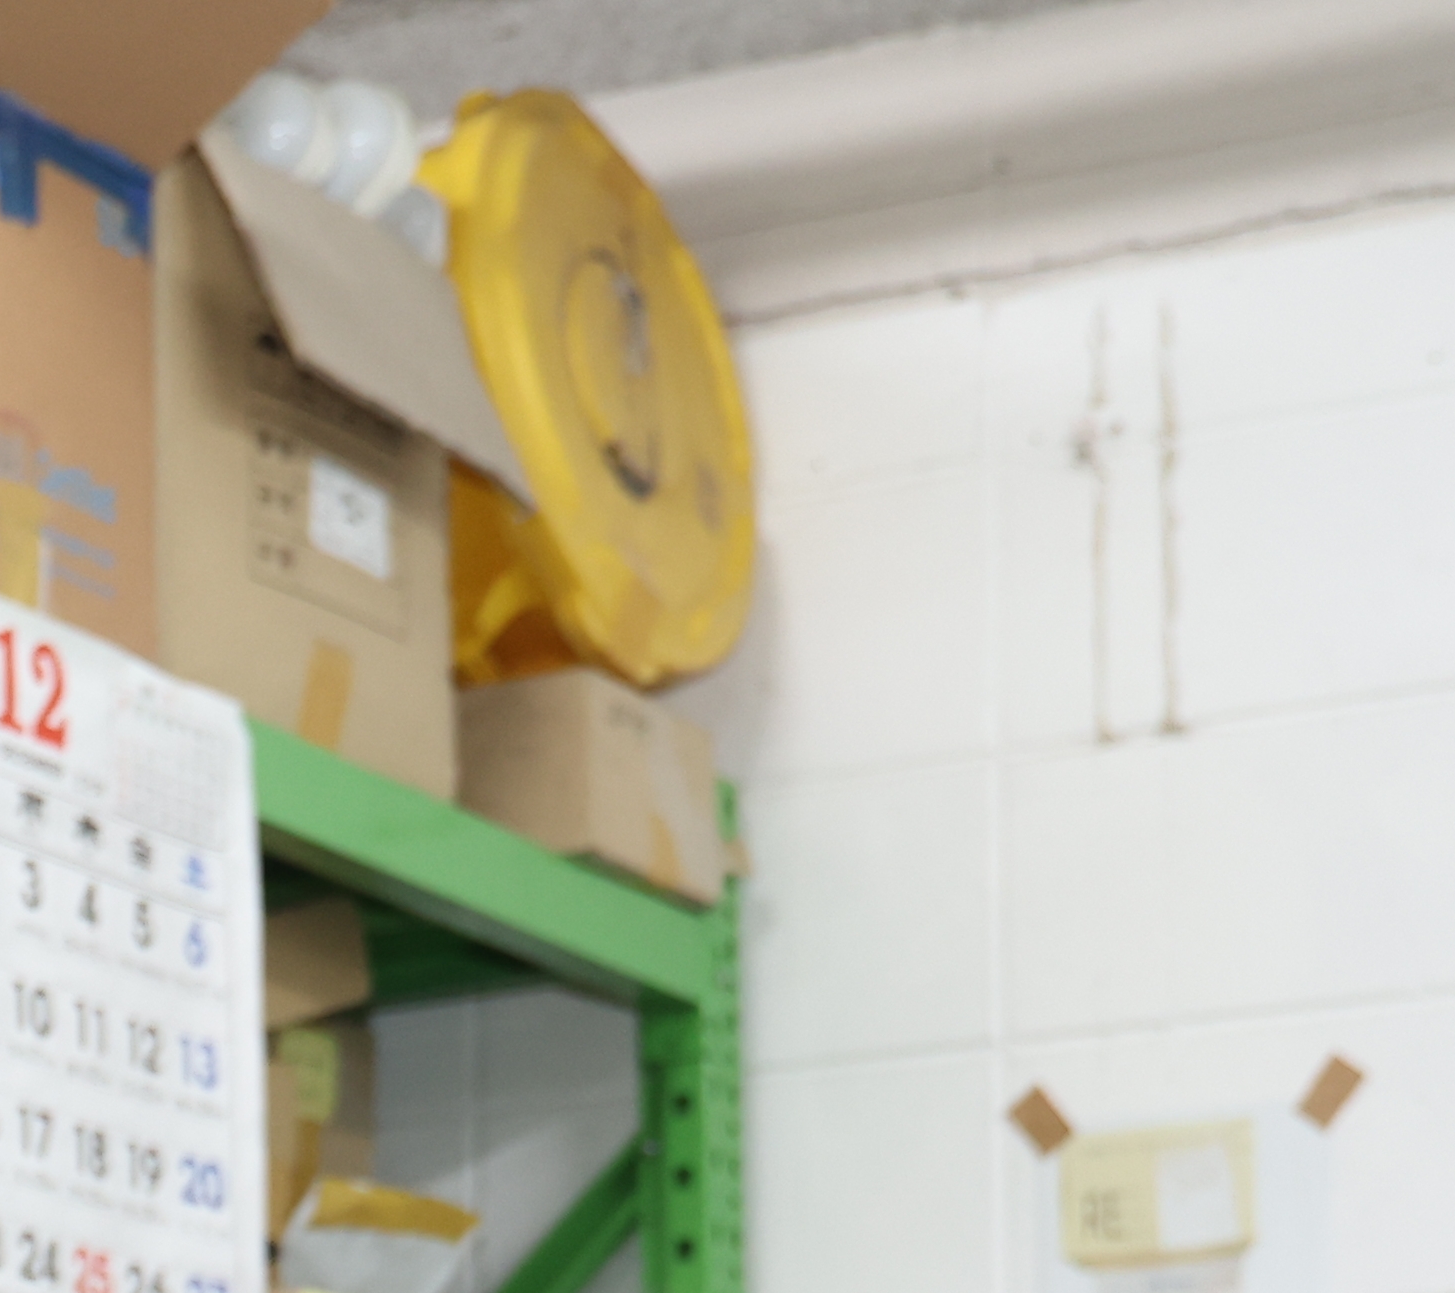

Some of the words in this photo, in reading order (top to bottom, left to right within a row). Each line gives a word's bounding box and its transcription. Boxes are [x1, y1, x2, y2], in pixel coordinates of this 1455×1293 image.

[21, 859, 42, 911] 3
[79, 883, 99, 925] 4
[133, 900, 154, 949] 5
[186, 920, 207, 968] 6
[13, 980, 56, 1039] 10
[74, 1000, 108, 1057] 11
[127, 1018, 162, 1075] 12
[181, 1036, 218, 1091] 13
[18, 1105, 54, 1159] 17
[74, 1123, 109, 1180] 18
[127, 1142, 164, 1197] 19
[179, 1156, 225, 1212] 20
[18, 1230, 60, 1284] 24
